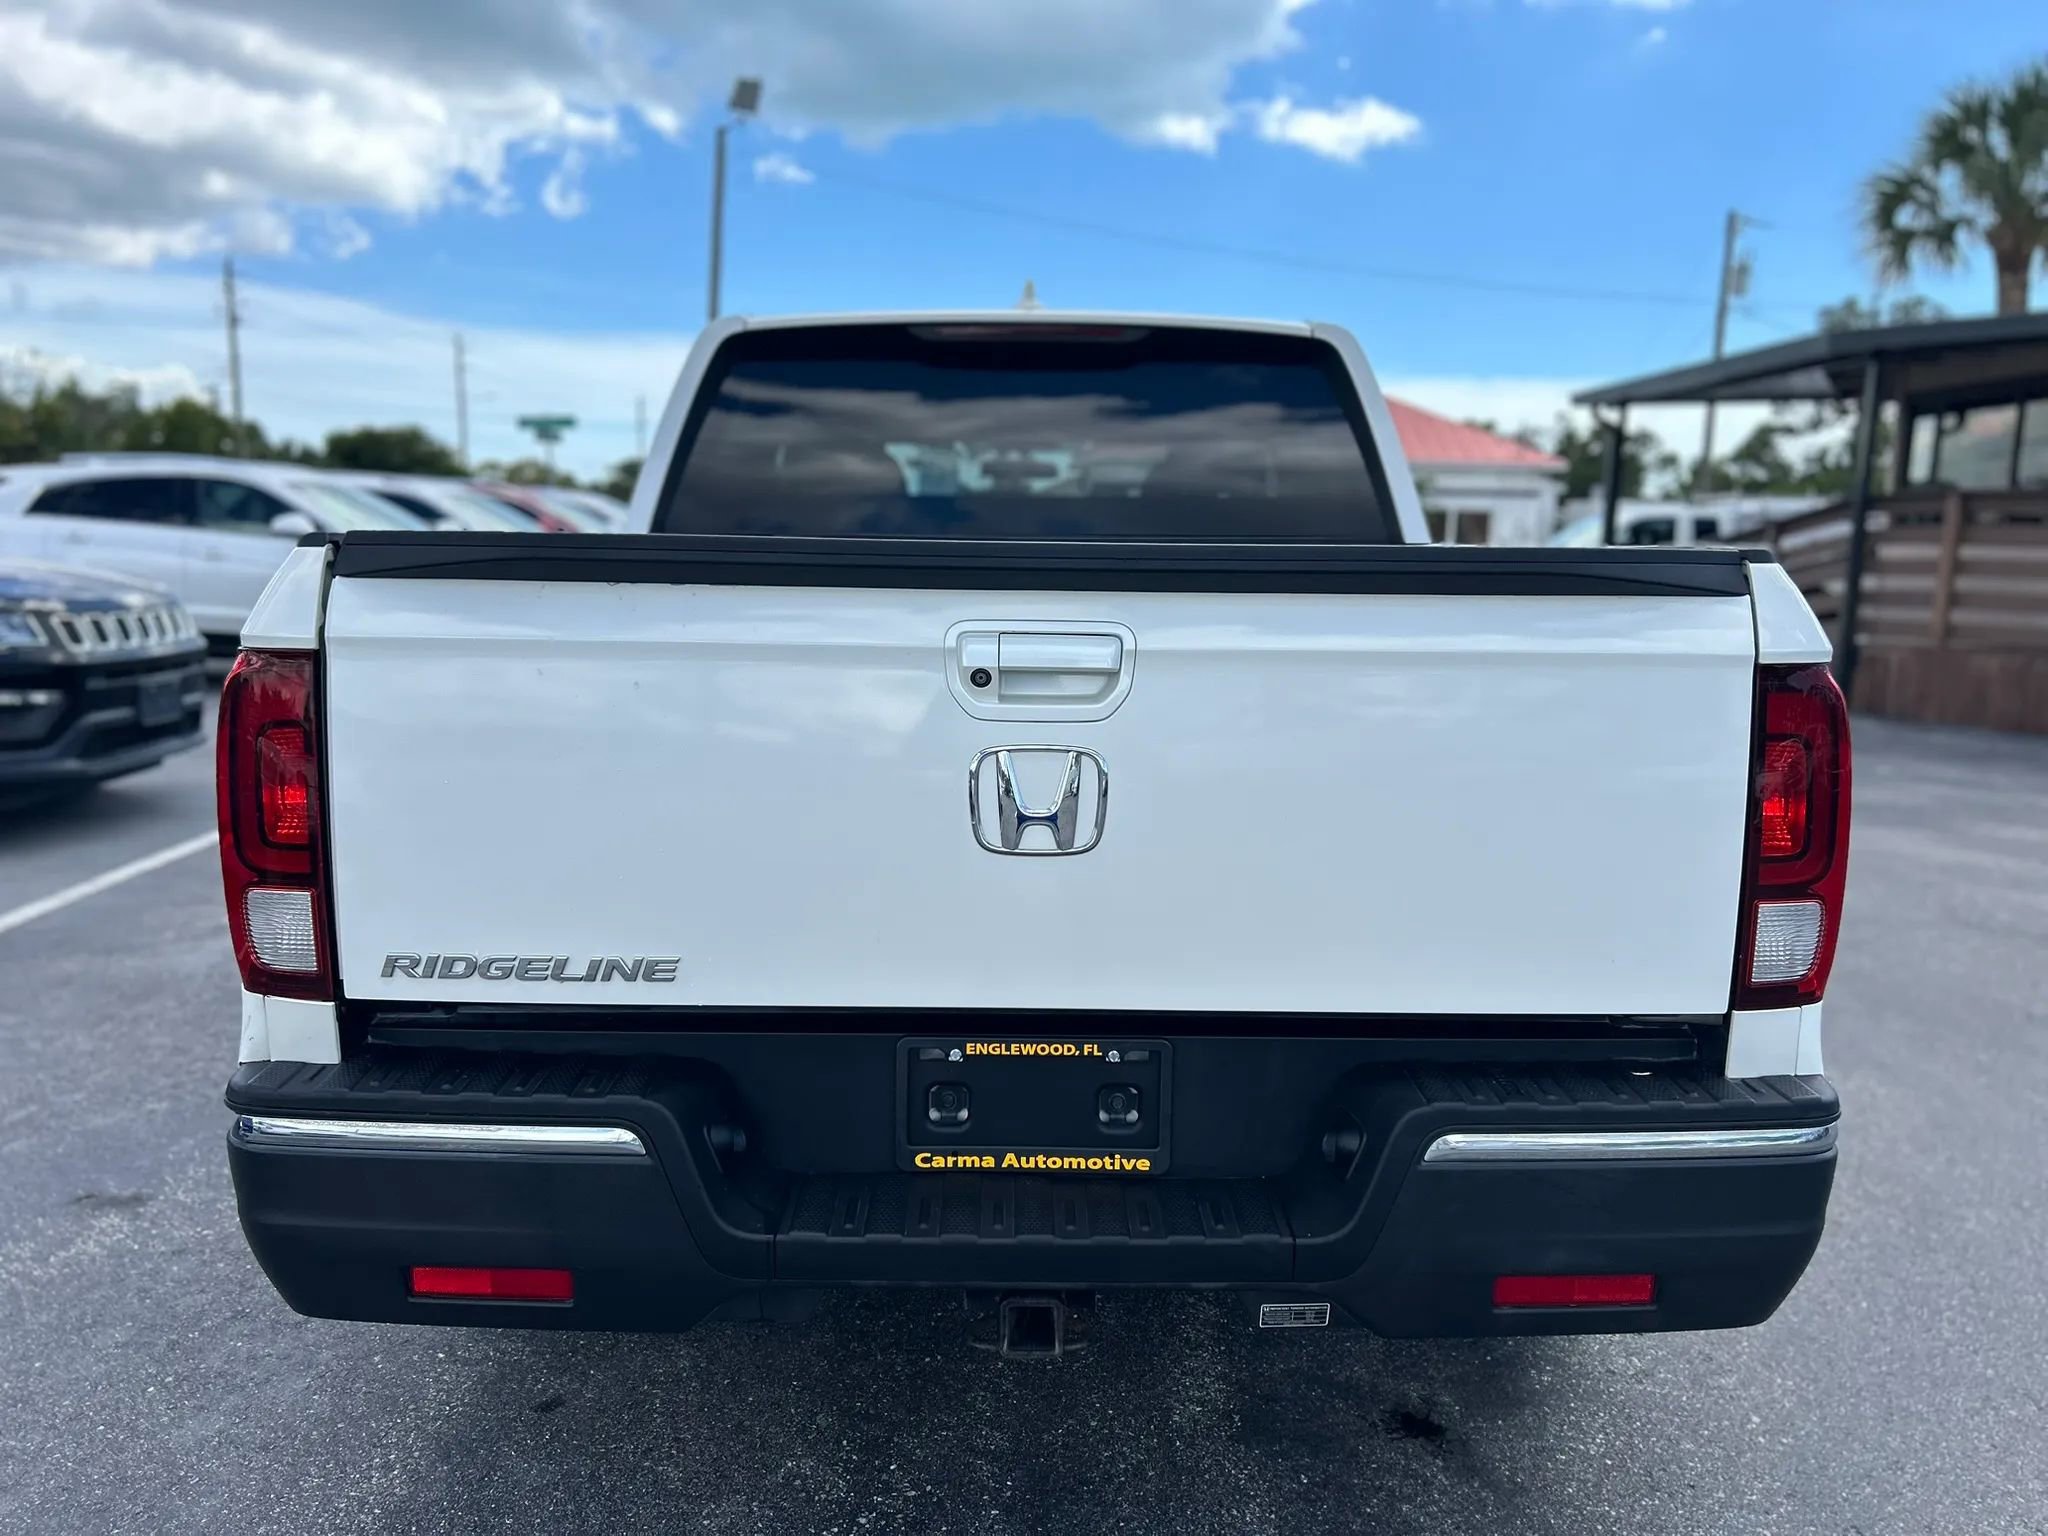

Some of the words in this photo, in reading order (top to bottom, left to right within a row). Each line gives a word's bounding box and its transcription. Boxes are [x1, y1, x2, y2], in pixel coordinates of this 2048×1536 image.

[380, 951, 682, 983] RIDGELINE
[965, 1043, 1080, 1056] ENGLEWOOD,
[1083, 1044, 1103, 1056] FL
[914, 1153, 995, 1168] Carma
[1001, 1153, 1151, 1171] Automotive
